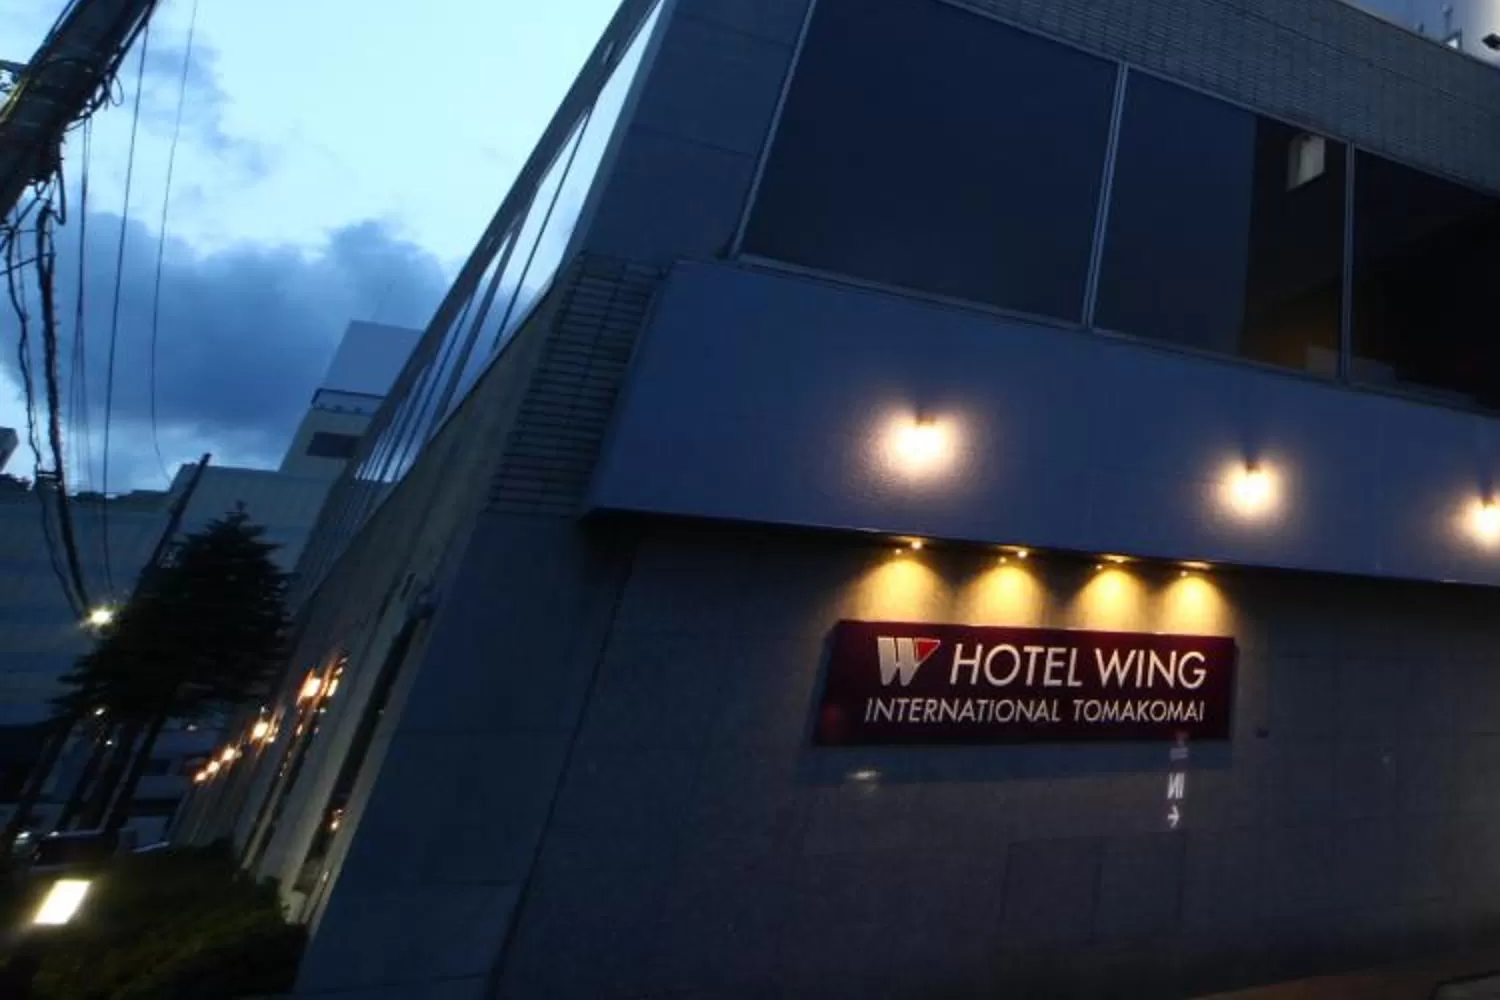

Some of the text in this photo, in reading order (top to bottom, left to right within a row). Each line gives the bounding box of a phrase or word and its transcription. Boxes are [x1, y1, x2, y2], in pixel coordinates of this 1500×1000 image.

[949, 643, 1083, 688] HOTEL
[1095, 647, 1206, 690] WING
[864, 698, 1205, 723] INTERNATIONAL TOMAKOMAI
